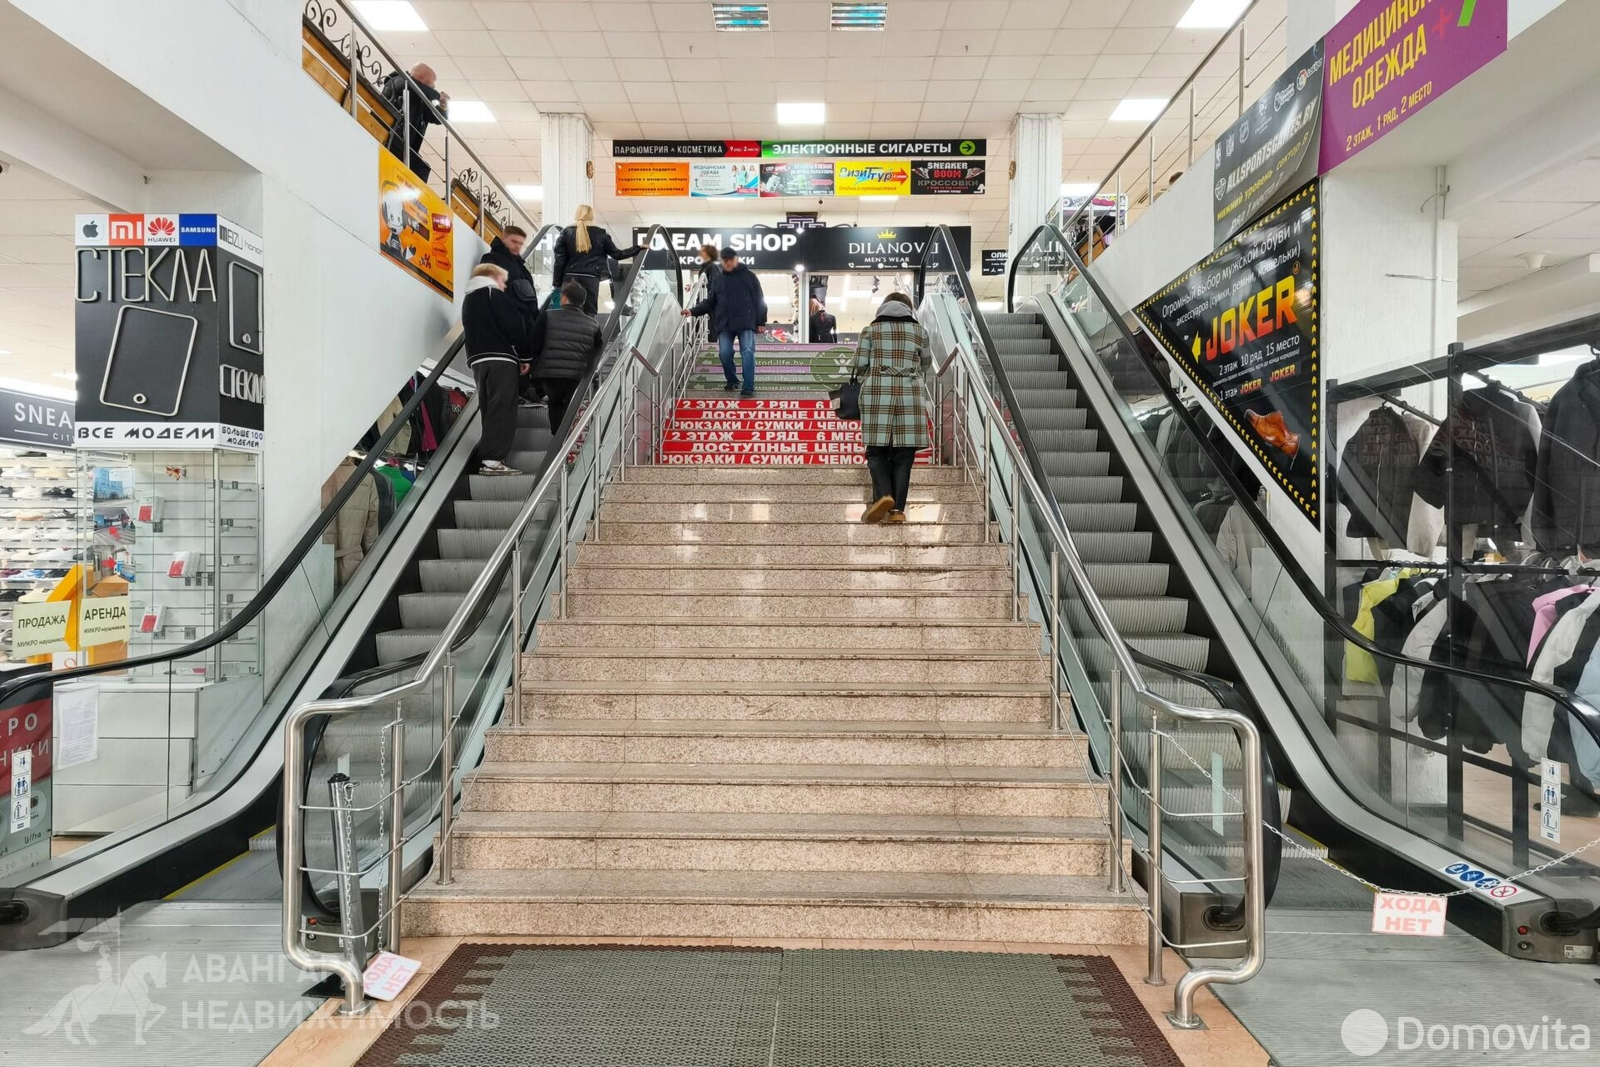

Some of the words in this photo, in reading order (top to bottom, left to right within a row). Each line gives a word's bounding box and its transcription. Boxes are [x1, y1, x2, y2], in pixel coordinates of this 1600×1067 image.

[1352, 23, 1427, 109] ОДЕЖДА
[1346, 135, 1352, 151] 2
[1401, 95, 1407, 115] 2
[1408, 81, 1433, 107] МЕСТО
[614, 145, 669, 154] ПАРФЮМЕРИЯ
[677, 144, 723, 154] КОСМЕТИКА
[772, 144, 876, 154] ЭЛЕКТРОННЫЕ
[879, 143, 952, 153] СИГАРЕТЫ
[933, 169, 962, 178] BOOM
[180, 226, 217, 234] SAMSUNG
[218, 224, 244, 251] MEIZU
[637, 233, 722, 251] DEAM
[729, 233, 797, 252] SHOP
[679, 255, 755, 266] КРОКИ
[1161, 285, 1197, 318] Огромный
[1196, 272, 1221, 298] выбор
[1221, 242, 1260, 281] мужской
[1260, 228, 1291, 257] обуви
[1293, 218, 1301, 235] и
[74, 247, 217, 303] СТЕКЛА
[1176, 301, 1209, 327] аксессуаров
[1232, 275, 1257, 295] ремни,
[1205, 275, 1298, 361] JOKER
[1219, 364, 1224, 376] 2
[1223, 359, 1239, 374] этаж
[1240, 353, 1249, 367] 10
[1249, 350, 1263, 366] ряд
[1265, 342, 1275, 357] 15
[1276, 333, 1300, 352] место
[1269, 364, 1296, 383] JOKER
[219, 363, 268, 405] СТЕКЛА
[1240, 378, 1263, 394] JOKER
[1224, 387, 1238, 400] этаж
[682, 400, 691, 409] 2
[696, 400, 740, 409] ЭТАЖ
[756, 400, 765, 409] 2
[769, 400, 800, 409] РЯД
[815, 400, 825, 409] 6
[14, 402, 74, 430] SNEA
[701, 410, 808, 420] ДОСТУПНЫЕ
[813, 410, 836, 420] ЦЕ
[78, 427, 116, 439] ВСЕ
[124, 427, 215, 439] МОДЕЛИ
[754, 421, 804, 430] СУМКИ
[817, 421, 862, 430] ЧЕМО
[52, 432, 74, 442] CIT
[221, 426, 250, 438] БОЛЬШЕ
[251, 431, 264, 441] 100
[671, 431, 681, 441] 2
[686, 431, 734, 441] ЭТАЖ
[751, 431, 761, 441] 2
[765, 431, 800, 441] РЯД
[816, 431, 826, 441] 6
[831, 431, 862, 441] МЕС
[691, 442, 808, 453] ДОСТУПНЫЕ
[662, 454, 736, 465] РЮКЗАКИ
[749, 454, 804, 465] СУМКИ
[818, 454, 868, 465] ЧЕМО
[84, 606, 127, 621] АРЕНДА
[18, 614, 66, 629] ПРОДАЖА
[84, 626, 101, 634] МИКРО
[100, 624, 126, 633] наушников
[17, 640, 38, 648] МИКРО
[39, 636, 65, 645] наушнико
[0, 712, 38, 737] РО
[1379, 897, 1442, 914] ХОДА
[1384, 916, 1433, 932] НЕТ
[365, 956, 398, 991] ХОДА
[381, 964, 413, 994] НЕТ
